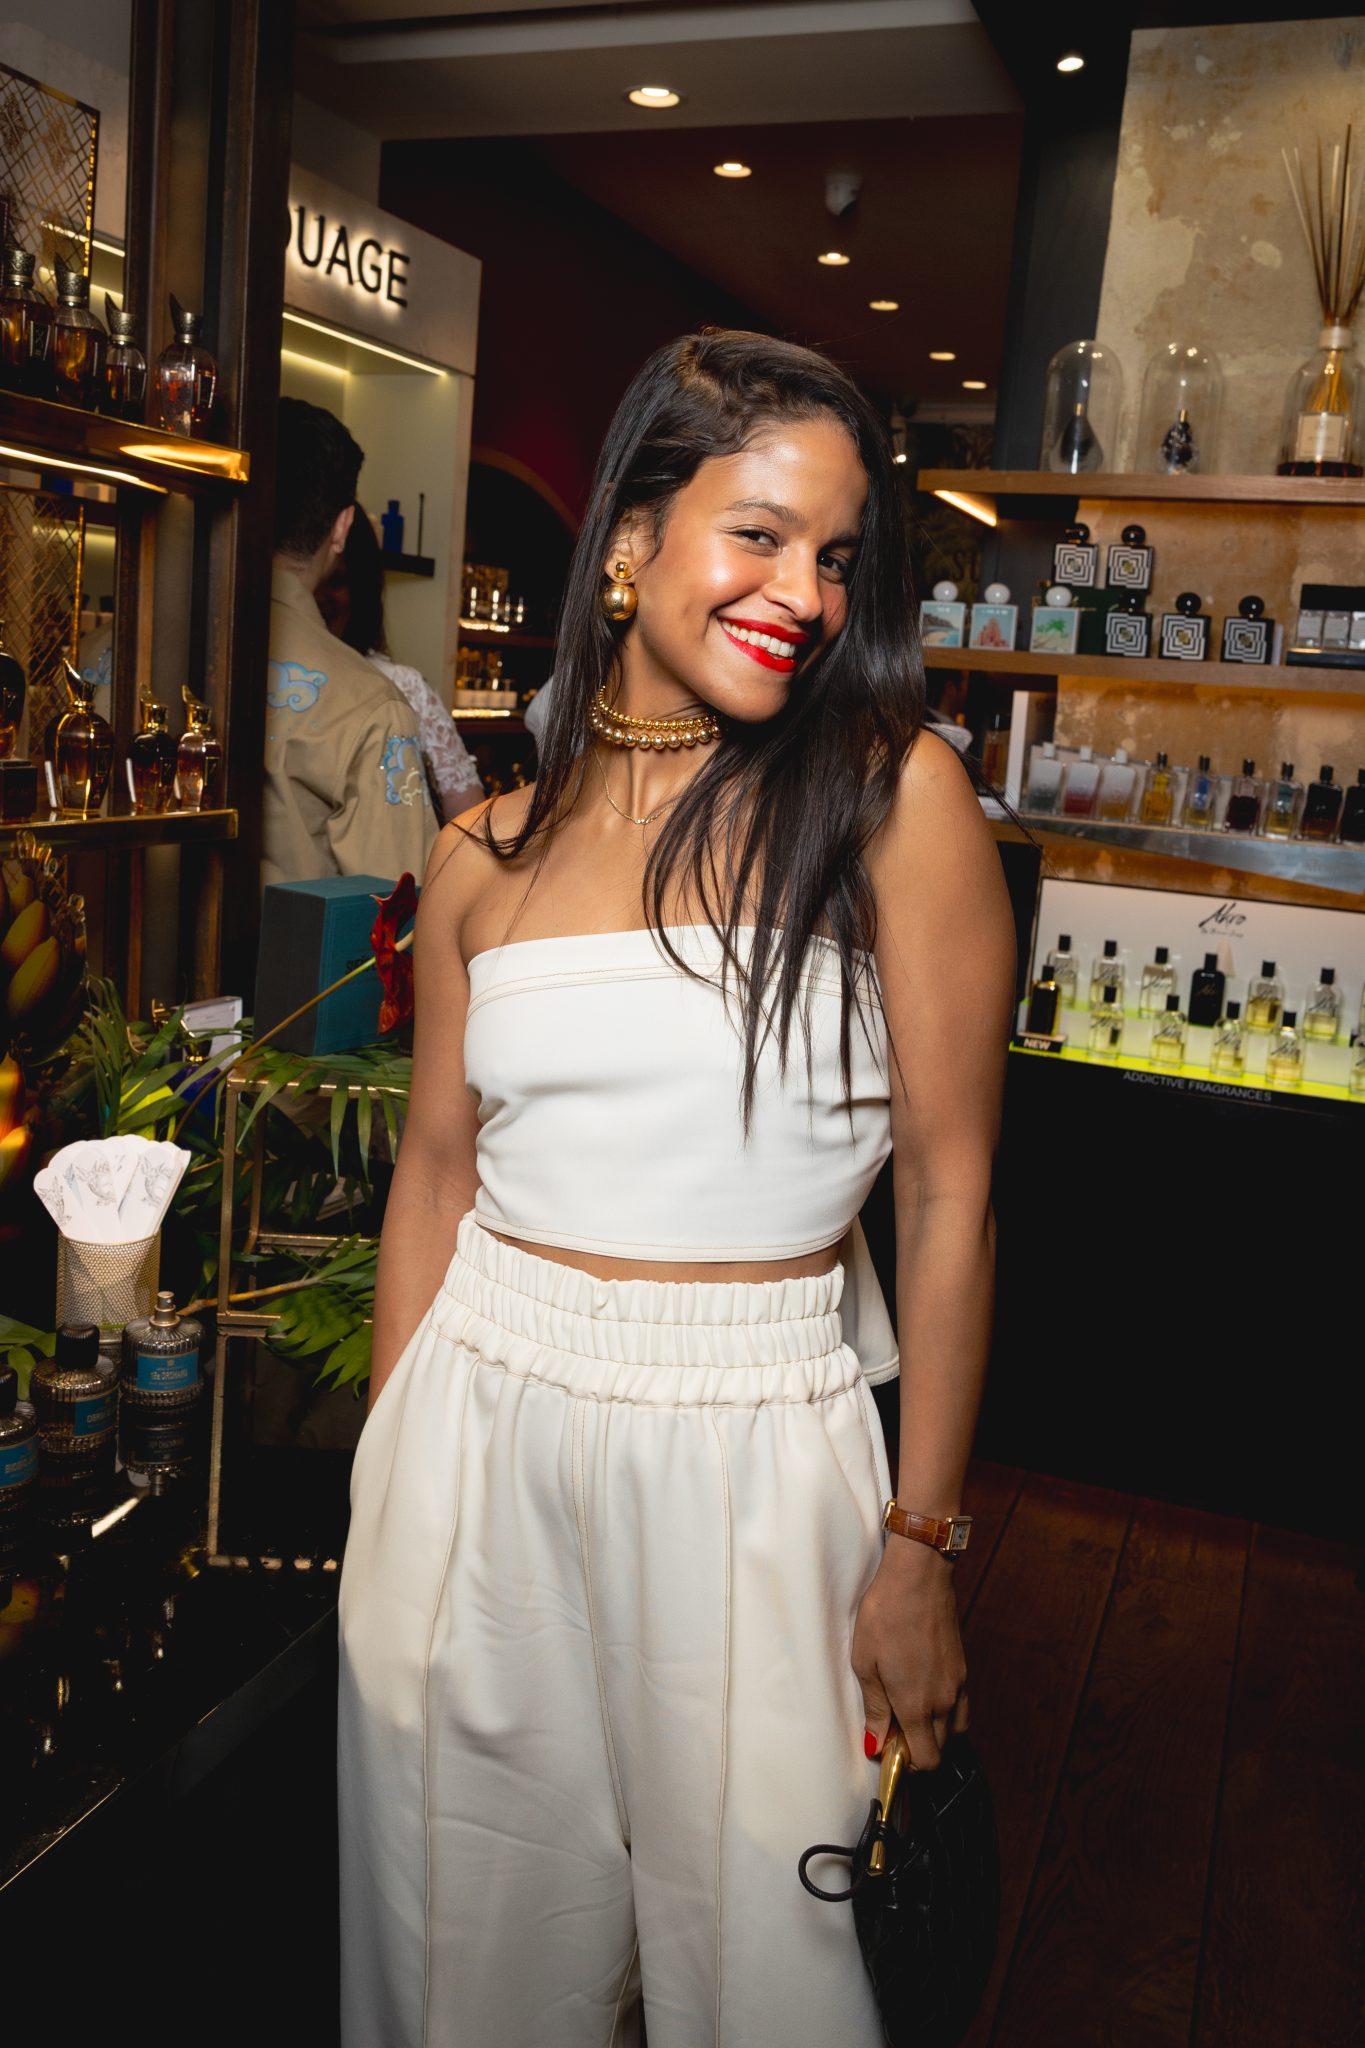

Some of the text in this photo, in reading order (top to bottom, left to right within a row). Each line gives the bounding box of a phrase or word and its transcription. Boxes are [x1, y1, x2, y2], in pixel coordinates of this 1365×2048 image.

[285, 204, 411, 309] UAGE
[1024, 1038, 1051, 1050] NEW
[1123, 1071, 1272, 1101] ADDICTIVE FRAGRANCES
